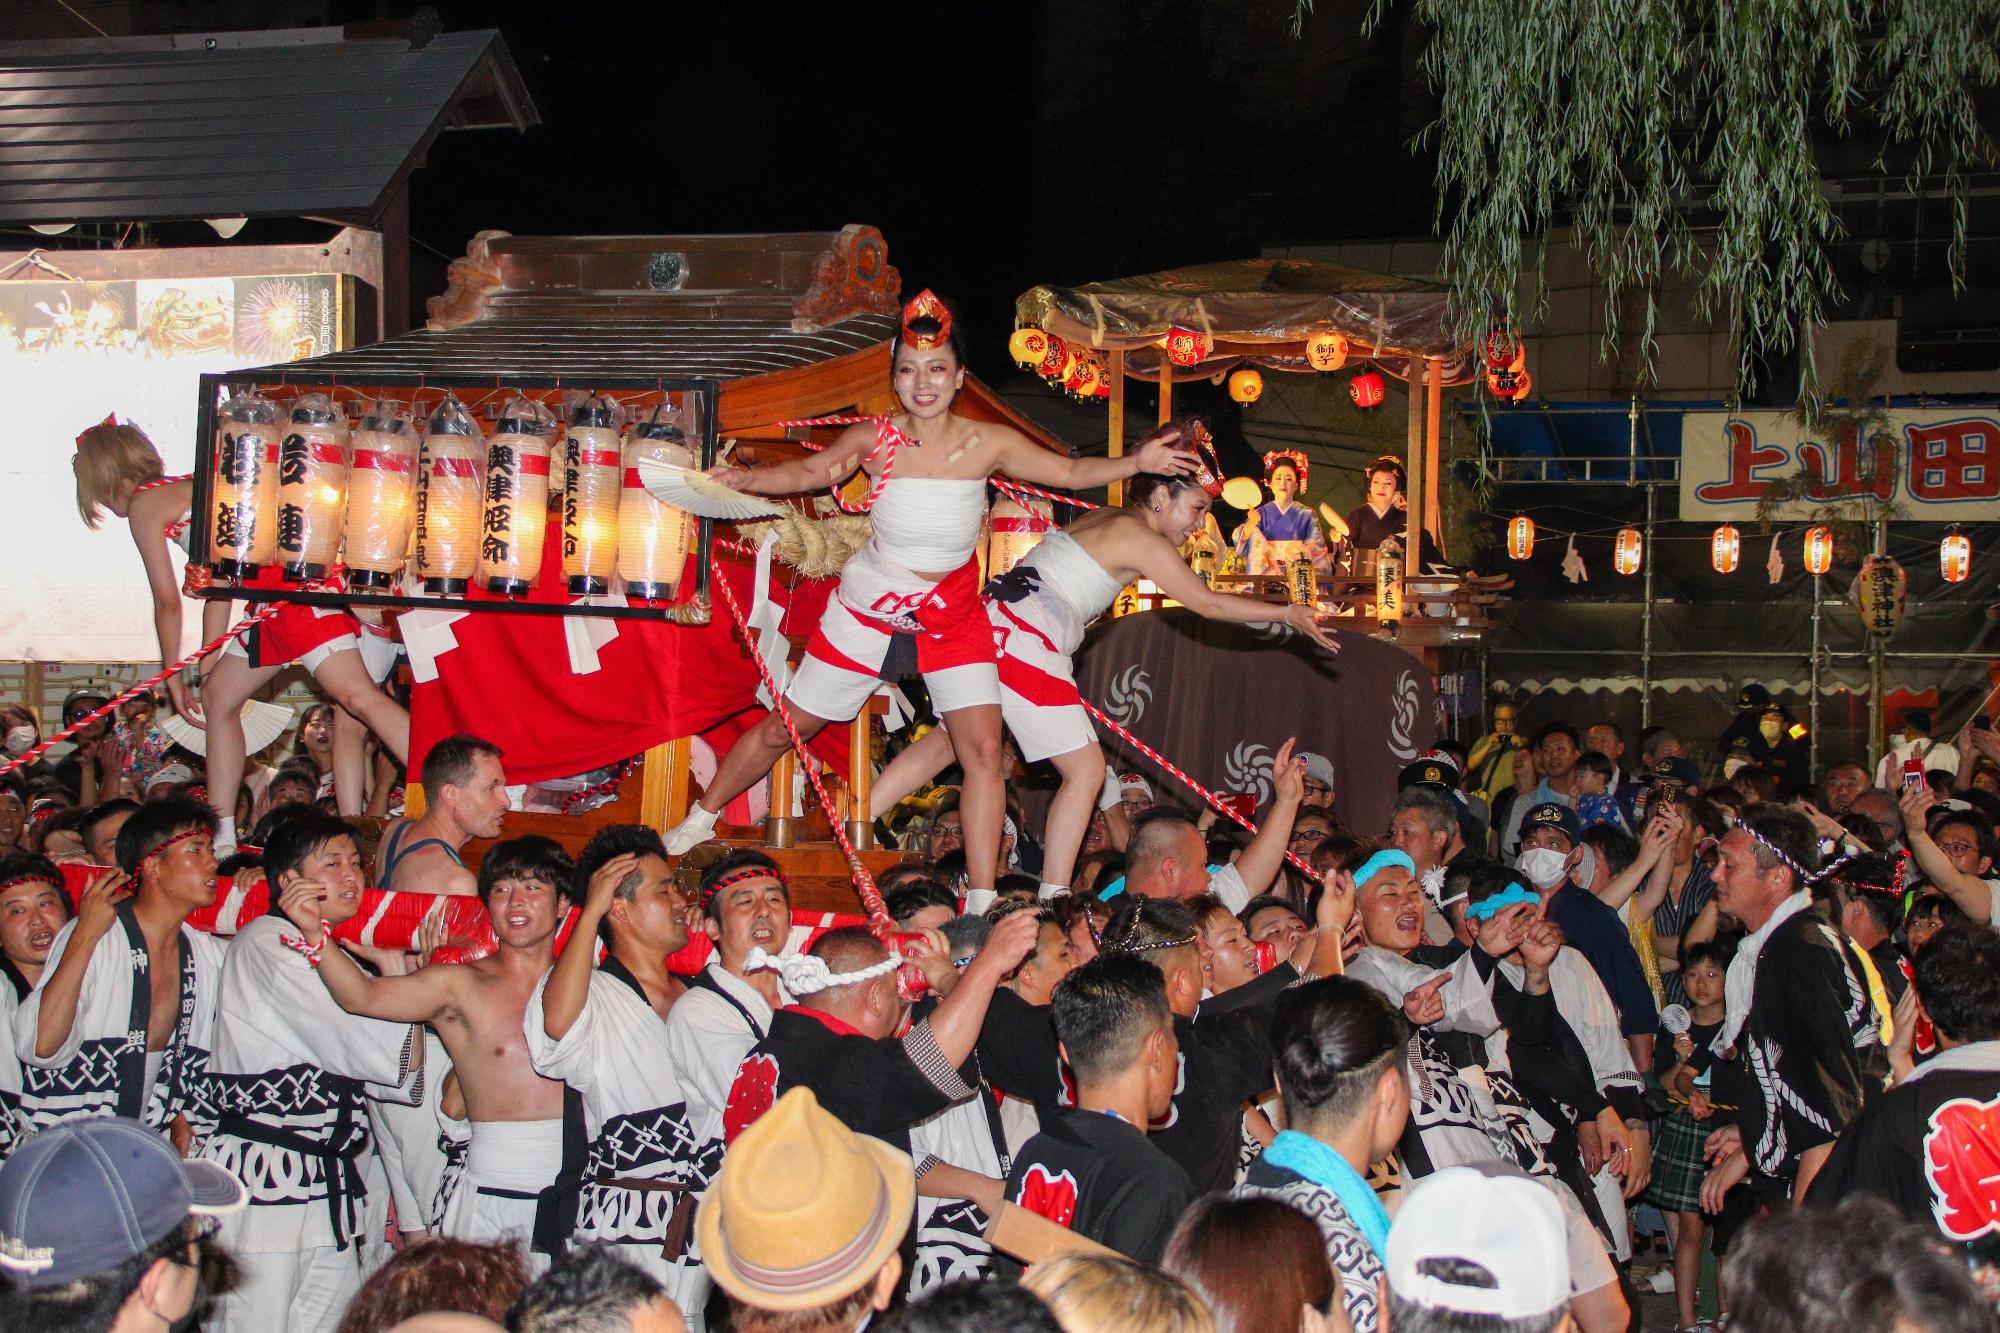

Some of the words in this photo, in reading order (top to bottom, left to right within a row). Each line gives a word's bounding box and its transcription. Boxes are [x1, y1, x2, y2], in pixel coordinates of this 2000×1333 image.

[1315, 343, 1335, 365] 獅子
[1696, 419, 2000, 502] 上山田
[176, 953, 198, 1058] 上山田温泉
